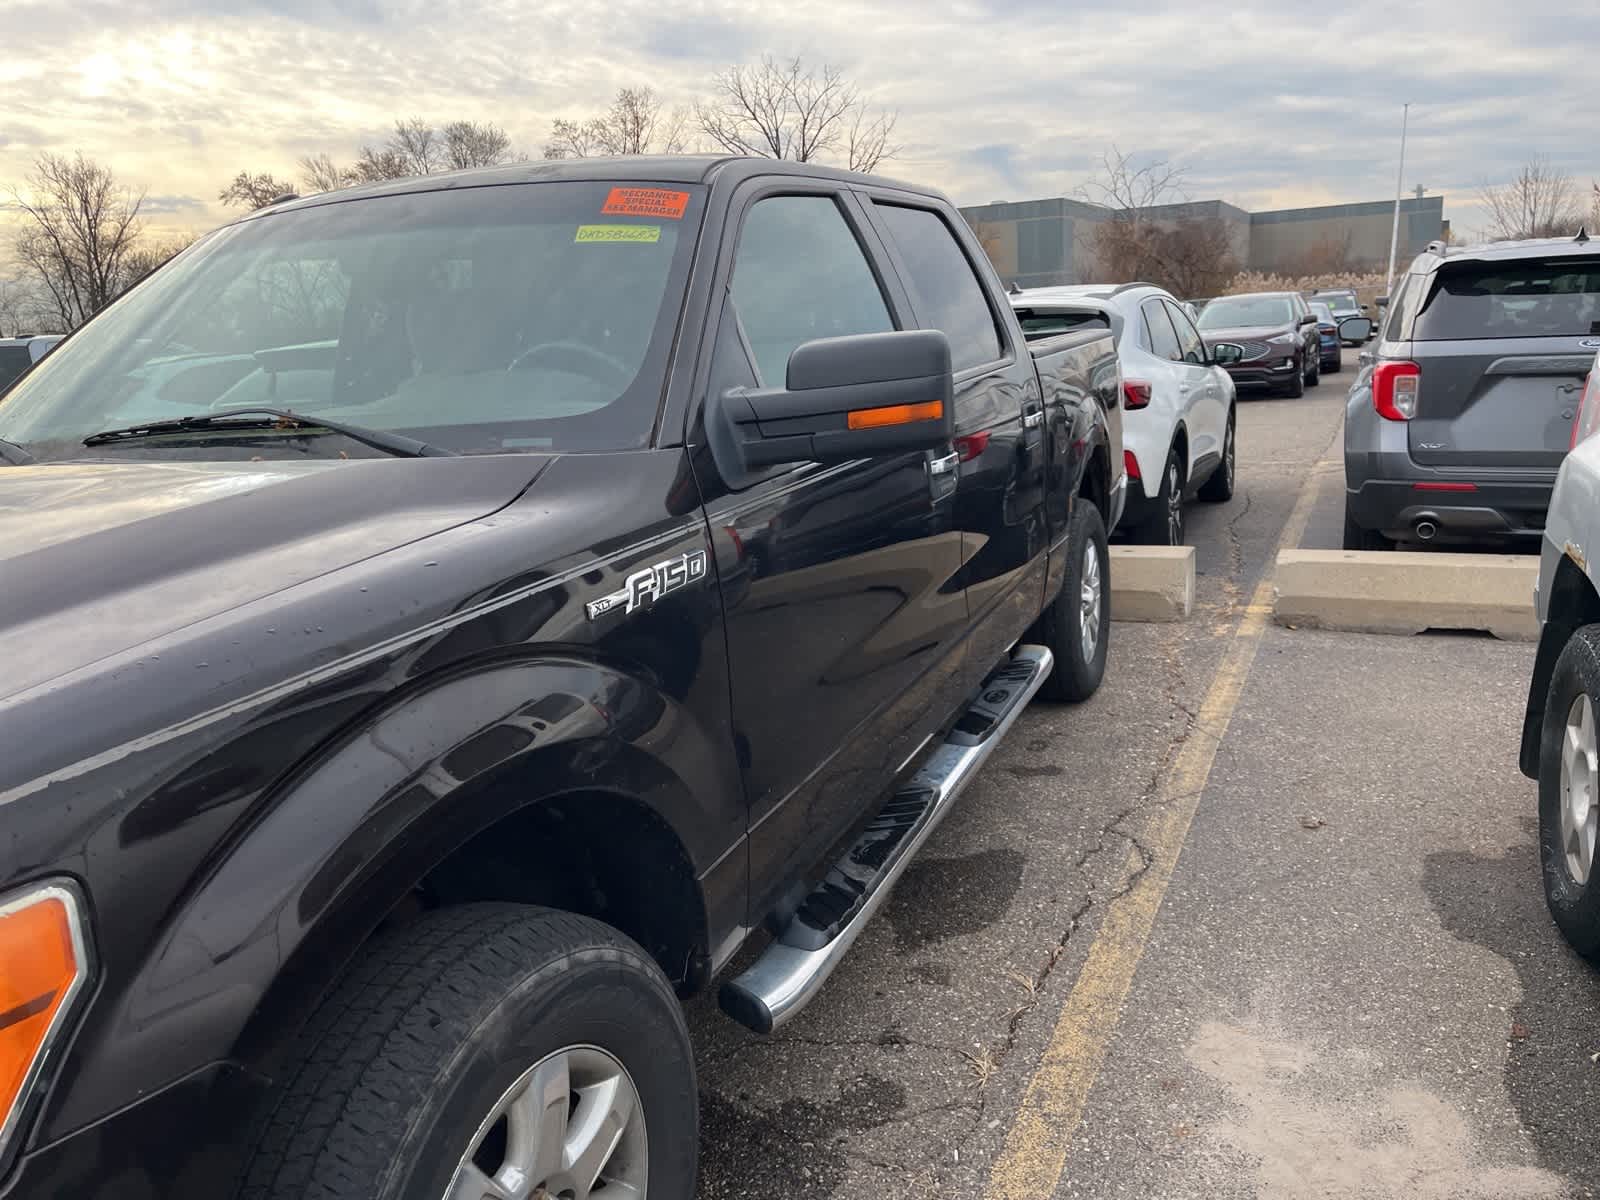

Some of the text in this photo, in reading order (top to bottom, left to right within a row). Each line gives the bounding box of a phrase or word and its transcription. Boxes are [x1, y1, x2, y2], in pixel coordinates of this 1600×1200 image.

[620, 190, 680, 200] MECHANICS
[623, 198, 667, 206] SPECIAL
[627, 205, 681, 216] MANAGER
[594, 599, 612, 614] XLT
